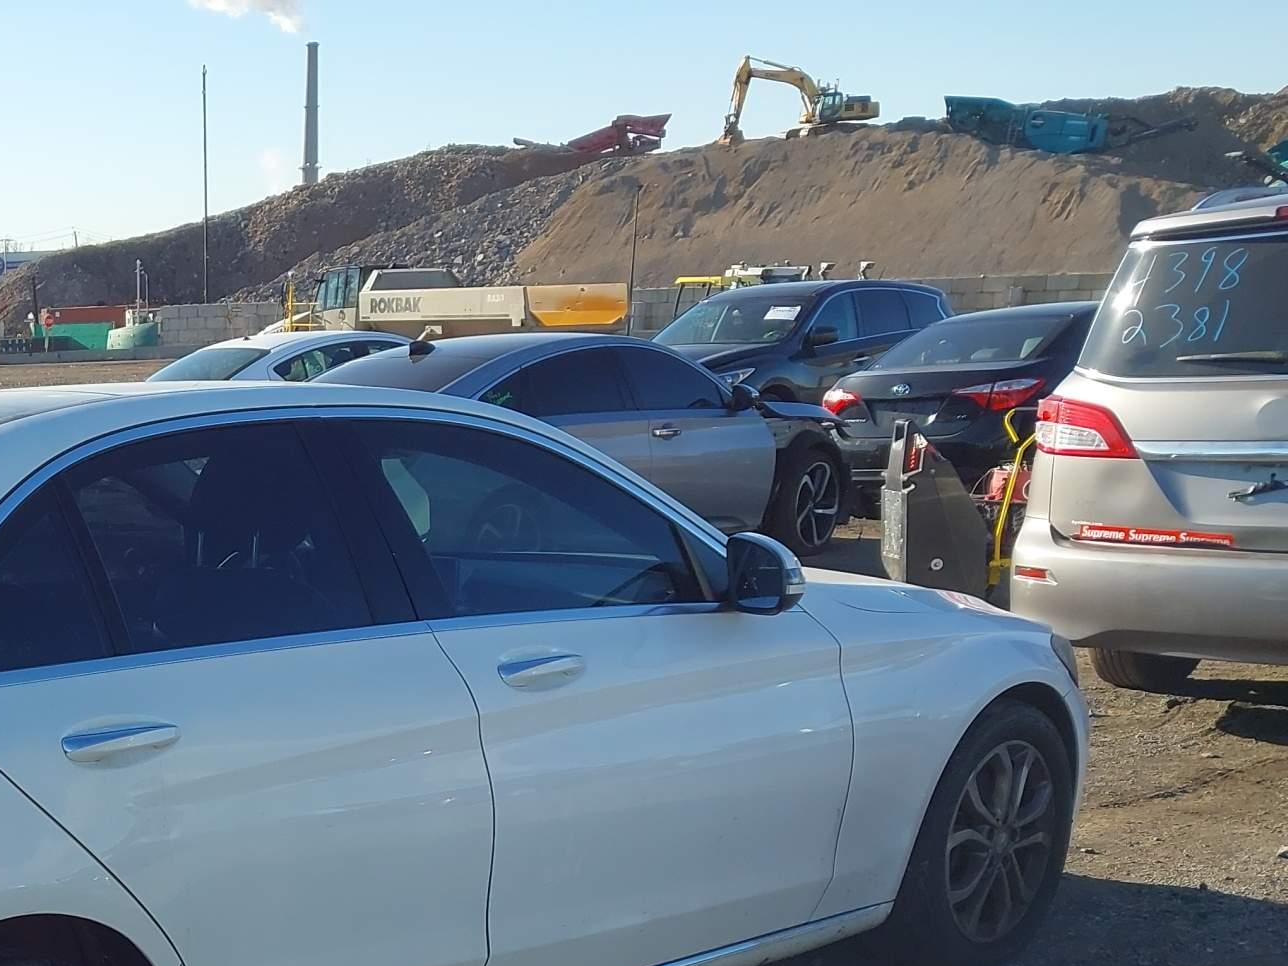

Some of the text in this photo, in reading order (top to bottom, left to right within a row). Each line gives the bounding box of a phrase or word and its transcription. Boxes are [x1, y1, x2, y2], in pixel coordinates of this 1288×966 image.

[370, 296, 422, 314] ROKBAK
[1122, 300, 1230, 348] 2381
[1082, 526, 1125, 540] Supreme
